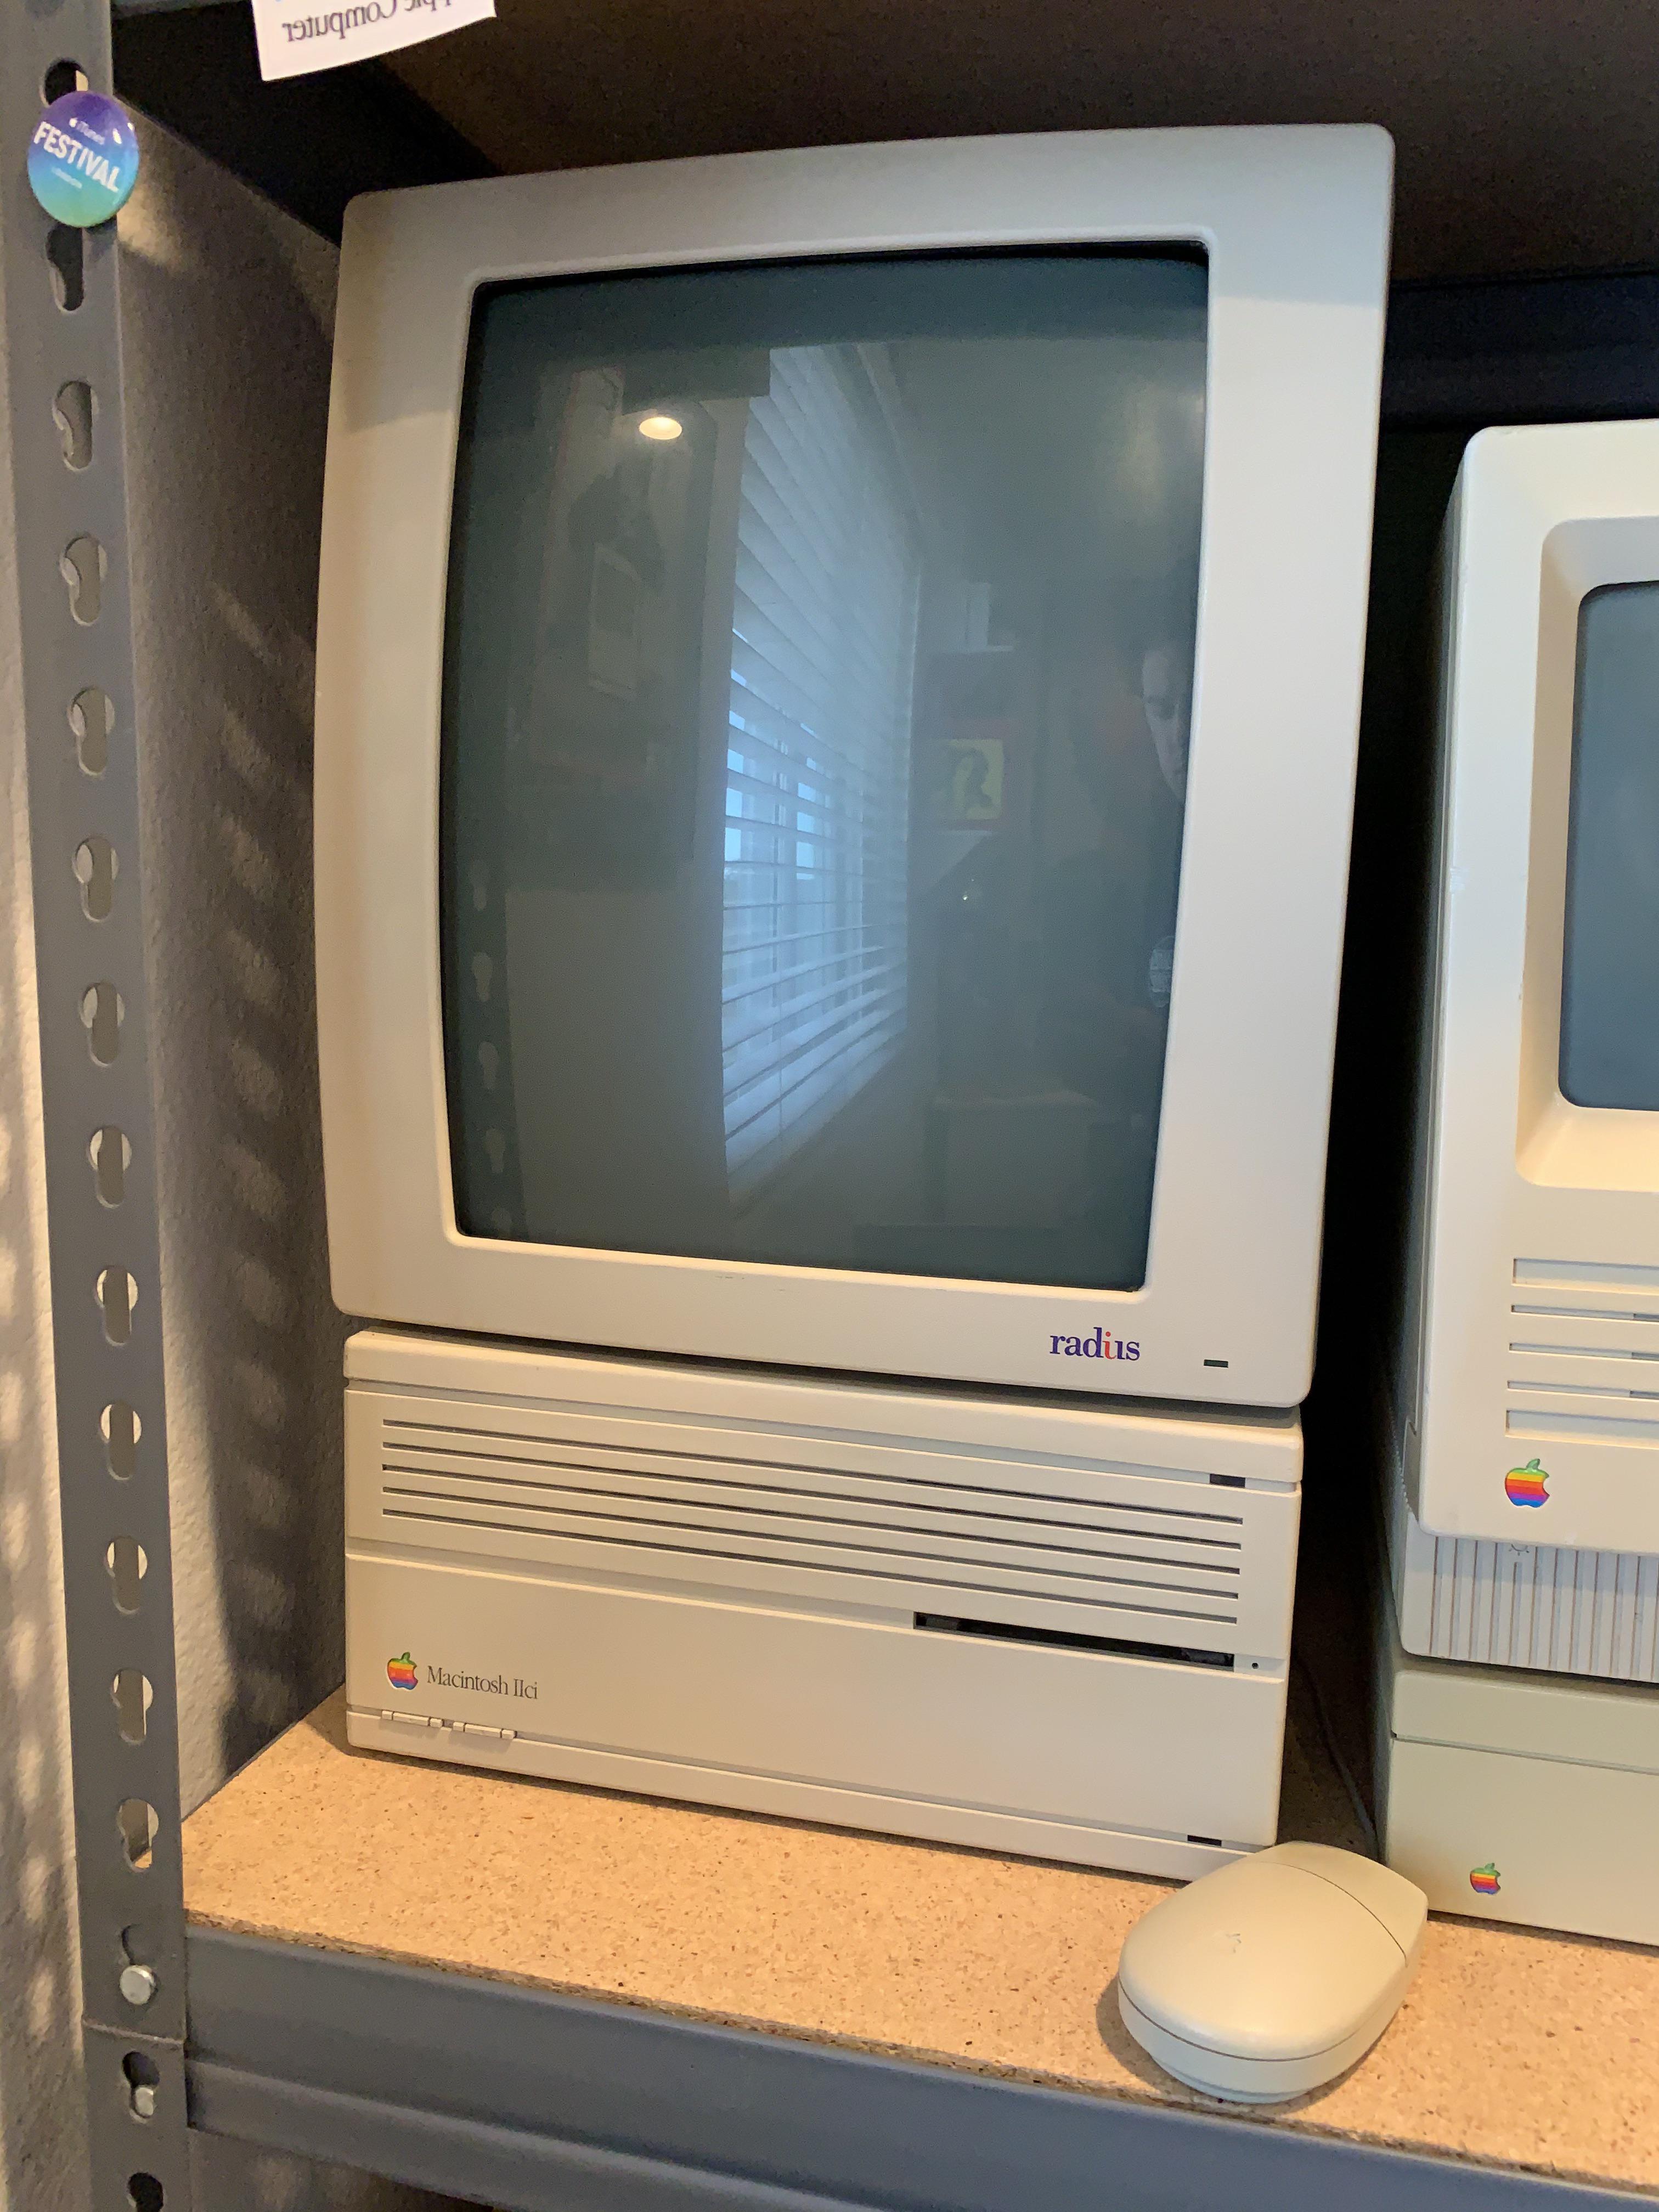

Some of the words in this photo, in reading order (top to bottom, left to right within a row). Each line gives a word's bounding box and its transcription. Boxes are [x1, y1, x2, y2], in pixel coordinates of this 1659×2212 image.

[33, 121, 119, 193] FESTIVAL
[1049, 1327, 1141, 1361] radius
[427, 1665, 509, 1696] Macintosh
[513, 1678, 538, 1700] IIci
